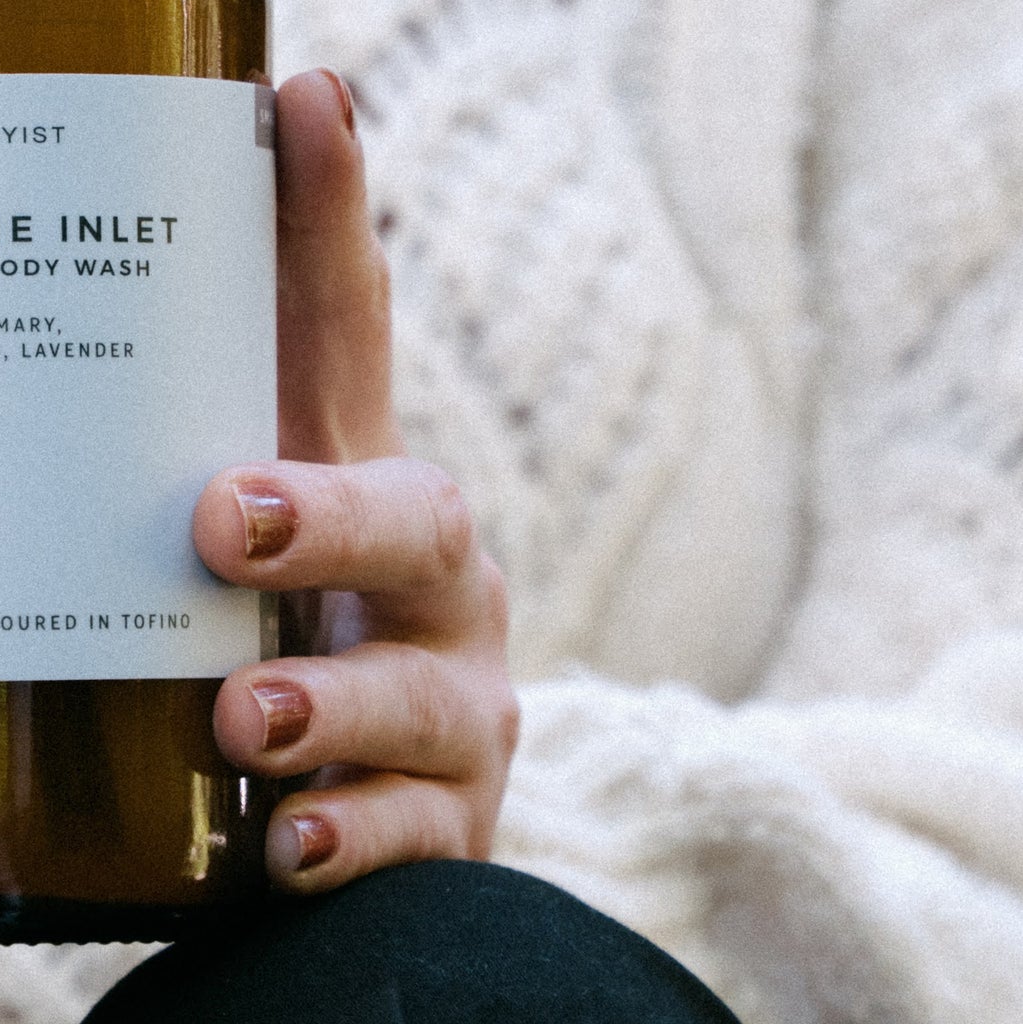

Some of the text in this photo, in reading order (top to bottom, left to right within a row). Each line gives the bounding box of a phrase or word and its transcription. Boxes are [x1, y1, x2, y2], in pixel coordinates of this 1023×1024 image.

[60, 214, 179, 245] INLET
[73, 258, 151, 278] WASH
[21, 341, 135, 359] LAVENDER
[88, 613, 110, 630] IN
[121, 613, 191, 630] TOFINO
